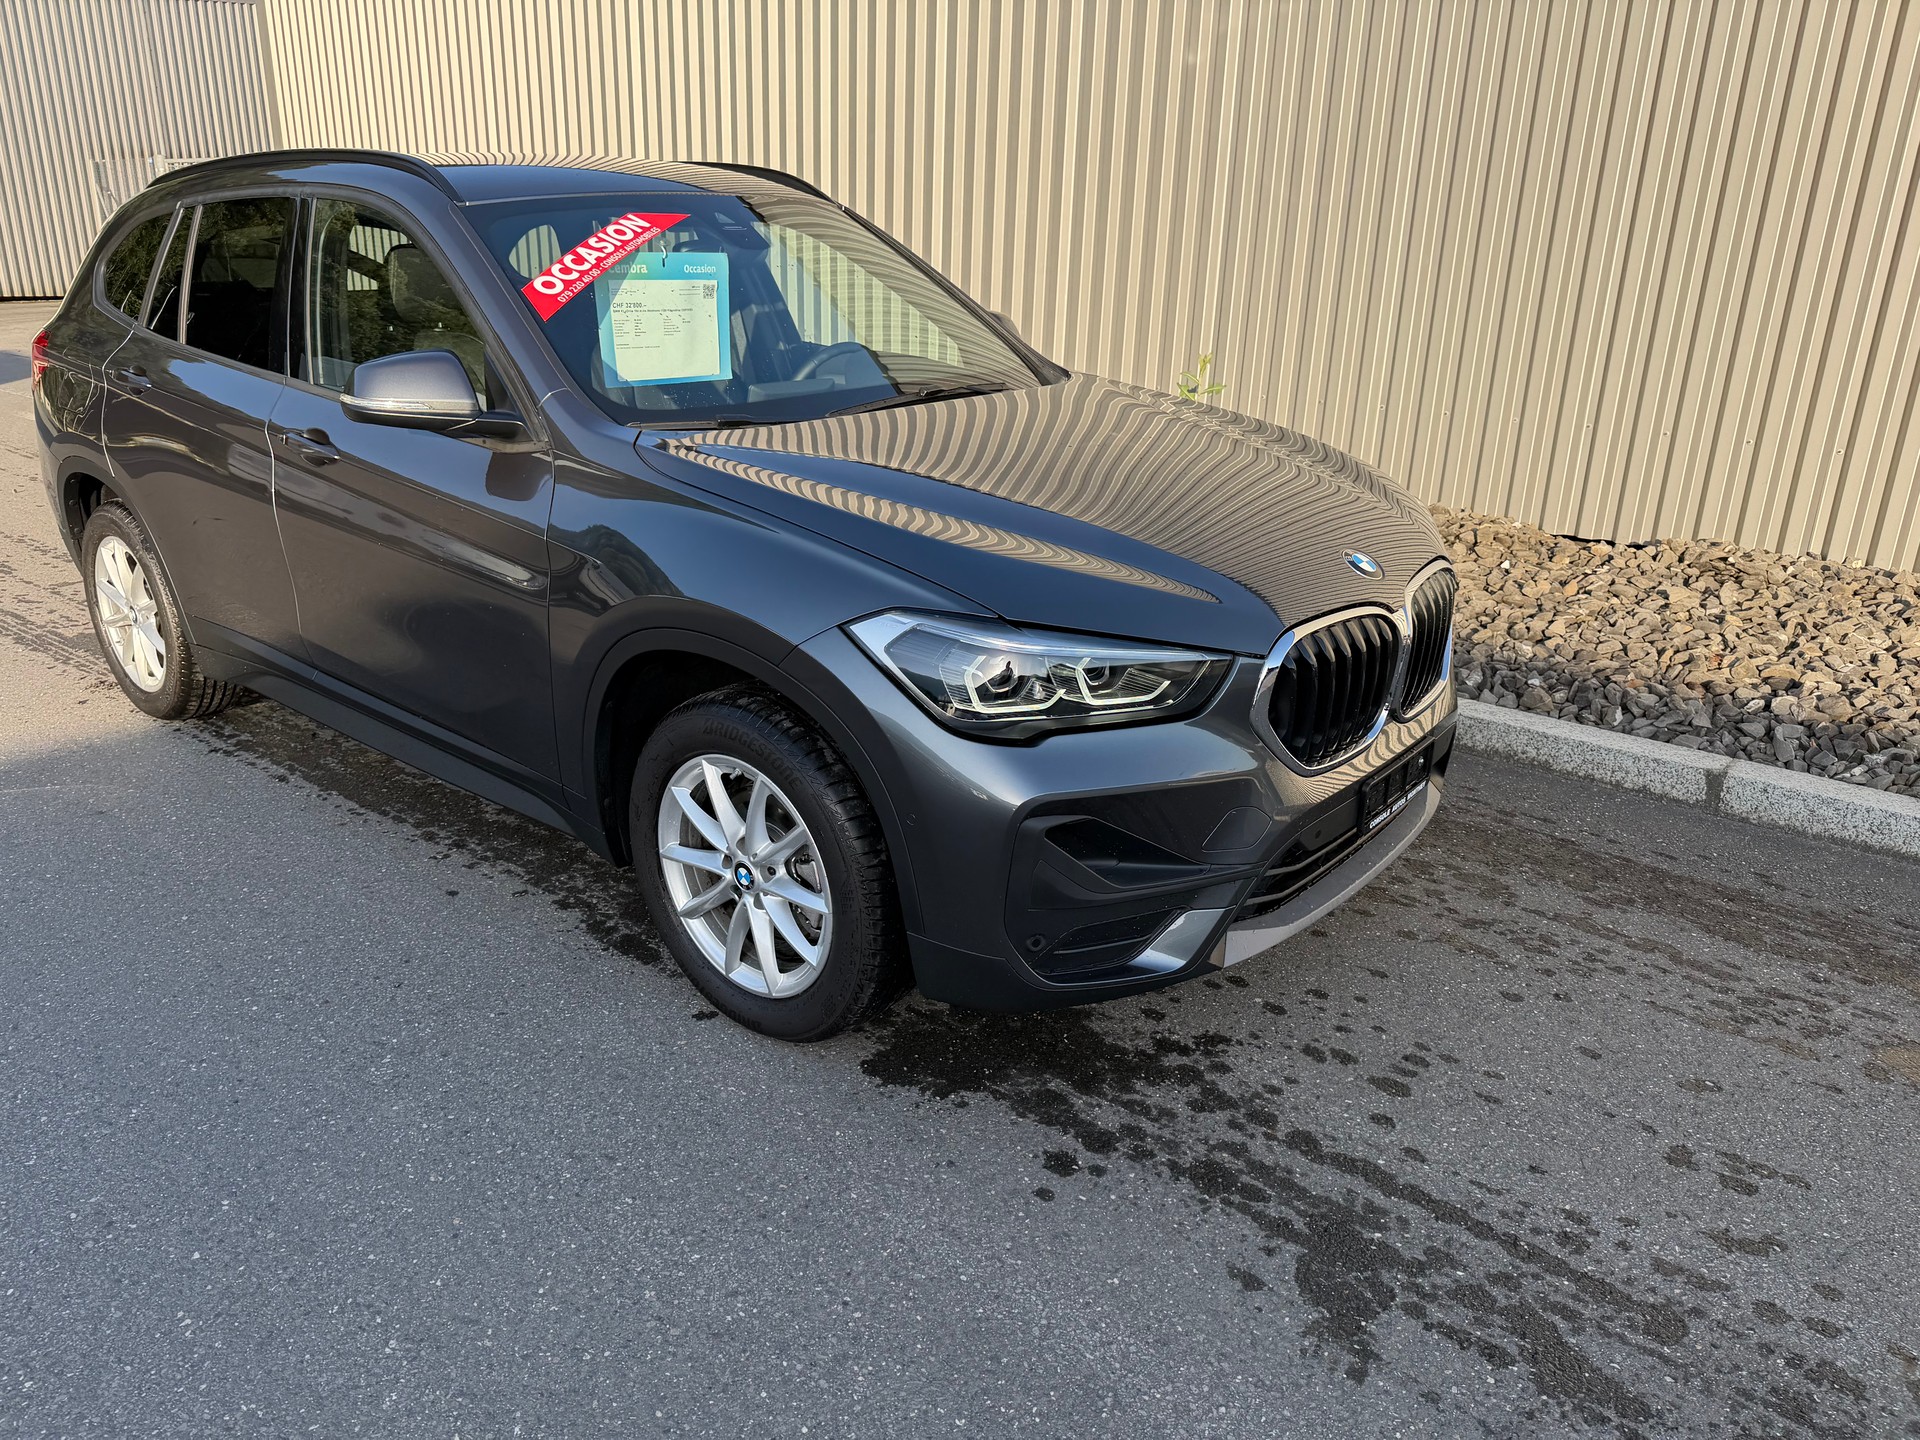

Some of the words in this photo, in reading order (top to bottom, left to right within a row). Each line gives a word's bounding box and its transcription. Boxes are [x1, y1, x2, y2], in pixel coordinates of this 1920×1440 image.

[533, 214, 652, 295] OCCASION
[557, 290, 573, 303] 079
[569, 281, 585, 293] 220
[581, 274, 593, 282] 40
[589, 268, 601, 277] 00
[600, 248, 628, 268] CONSOLE
[624, 226, 661, 252] AUTOMOBILES
[683, 264, 717, 274] Occasion
[1369, 808, 1391, 829] CONSOLE
[1391, 797, 1407, 813] AUTOS
